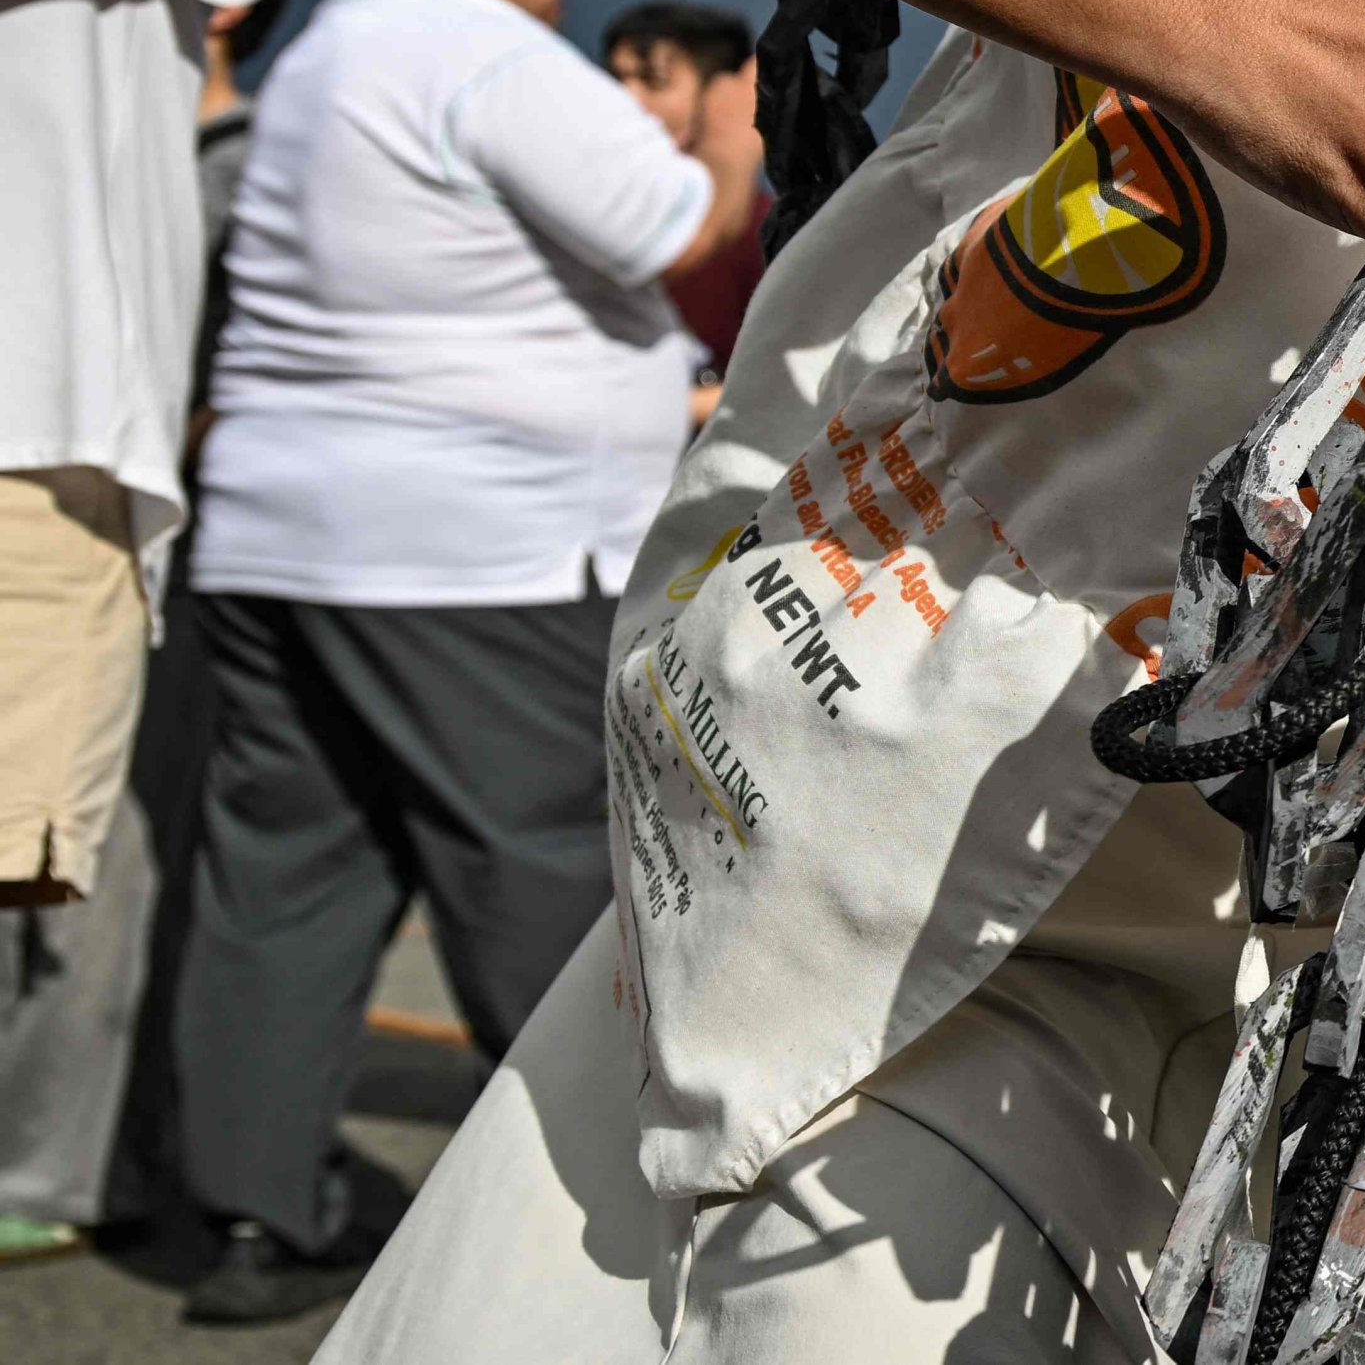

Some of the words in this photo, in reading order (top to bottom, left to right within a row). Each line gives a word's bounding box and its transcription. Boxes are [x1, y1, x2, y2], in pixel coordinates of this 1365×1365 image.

[657, 625, 688, 699] RAL
[682, 676, 769, 831] MILLING
[645, 800, 680, 885] Highway,
